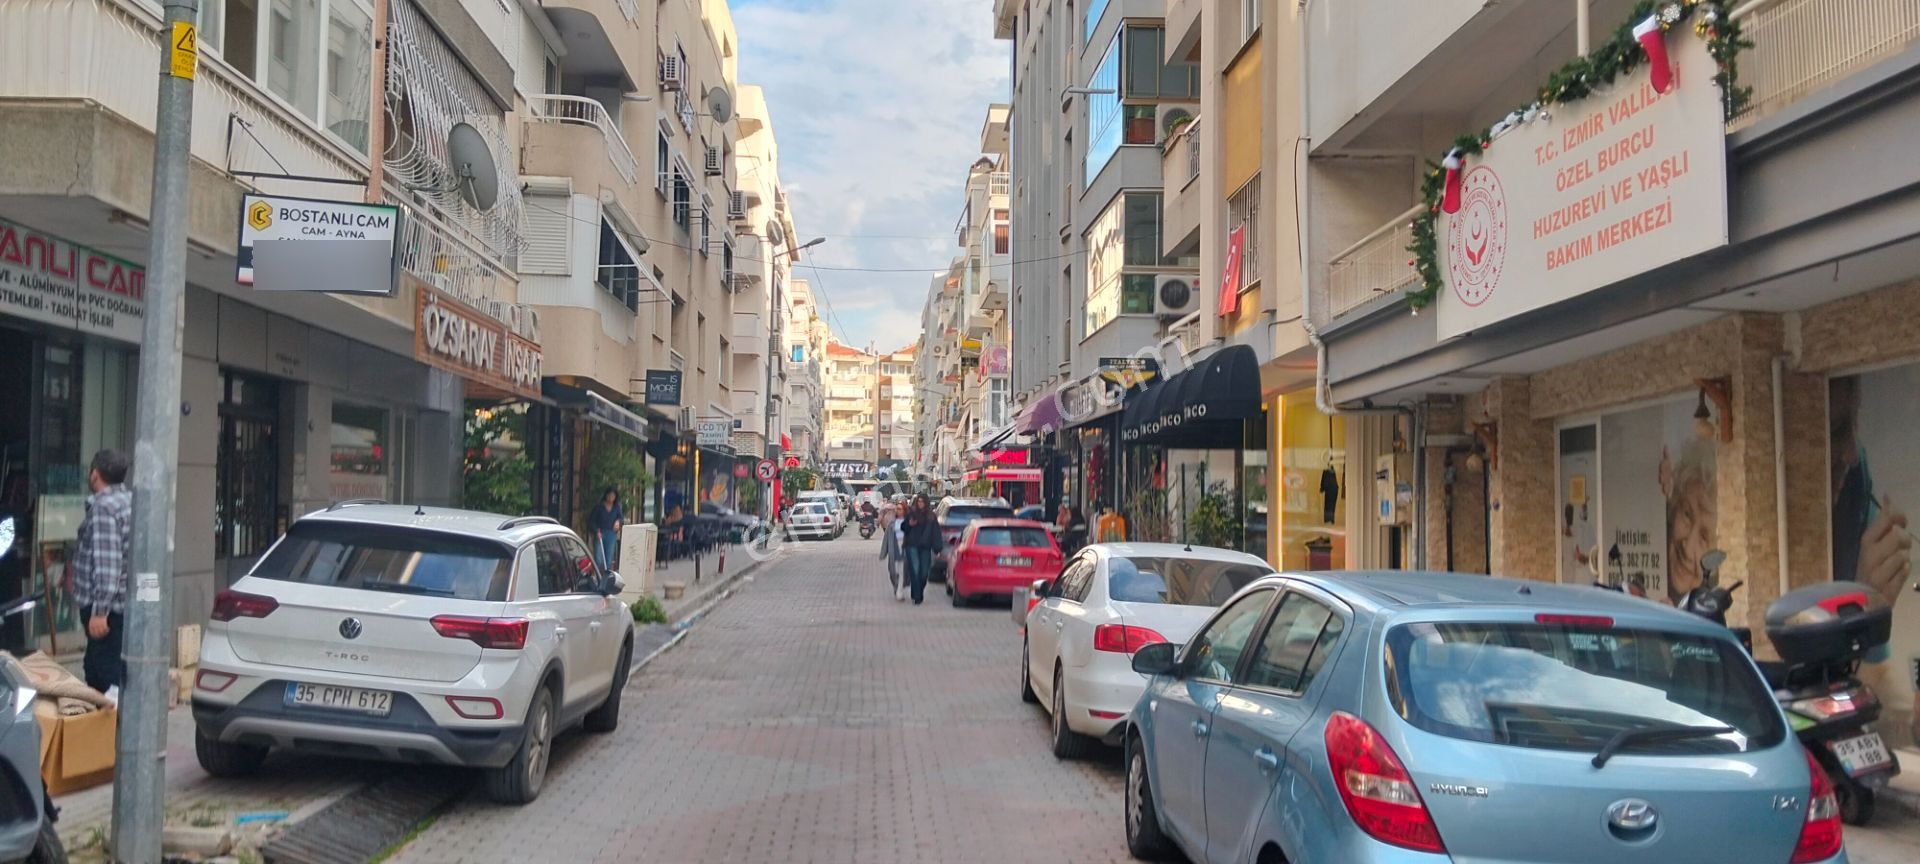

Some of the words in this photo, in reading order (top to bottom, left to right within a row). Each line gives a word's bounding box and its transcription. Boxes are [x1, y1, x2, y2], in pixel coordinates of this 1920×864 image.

[1535, 141, 1558, 165] T.C.
[1563, 112, 1604, 152] İZMİR
[1608, 61, 1681, 126] VALİLİ
[1556, 159, 1593, 192] ÖZEL
[1598, 124, 1654, 172] BURCU
[1533, 185, 1606, 239] HUZUREVİ
[1611, 177, 1632, 204] VE
[1638, 151, 1688, 189] YAŞLI
[280, 208, 353, 226] BOSTANLI
[357, 214, 389, 229] CAM
[302, 227, 326, 237] CAM
[336, 229, 365, 239] AYNA
[1547, 234, 1592, 271] BAKIM
[1598, 196, 1672, 251] MERKEZİ
[0, 224, 76, 280] ANLI
[20, 273, 75, 300] ALÜMİNYUM
[89, 293, 105, 308] PVC
[51, 301, 87, 322] TADİLAT
[90, 306, 114, 328] İŞLERİ
[423, 292, 497, 370] ÖZSARAY
[650, 384, 677, 393] MORE
[670, 375, 678, 383] IS
[325, 651, 370, 661] T-ROC
[296, 684, 316, 702] 35
[323, 687, 352, 705] CPH
[358, 691, 388, 709] 612
[1837, 741, 1855, 756] 35
[1430, 783, 1488, 798] HYUNDAI
